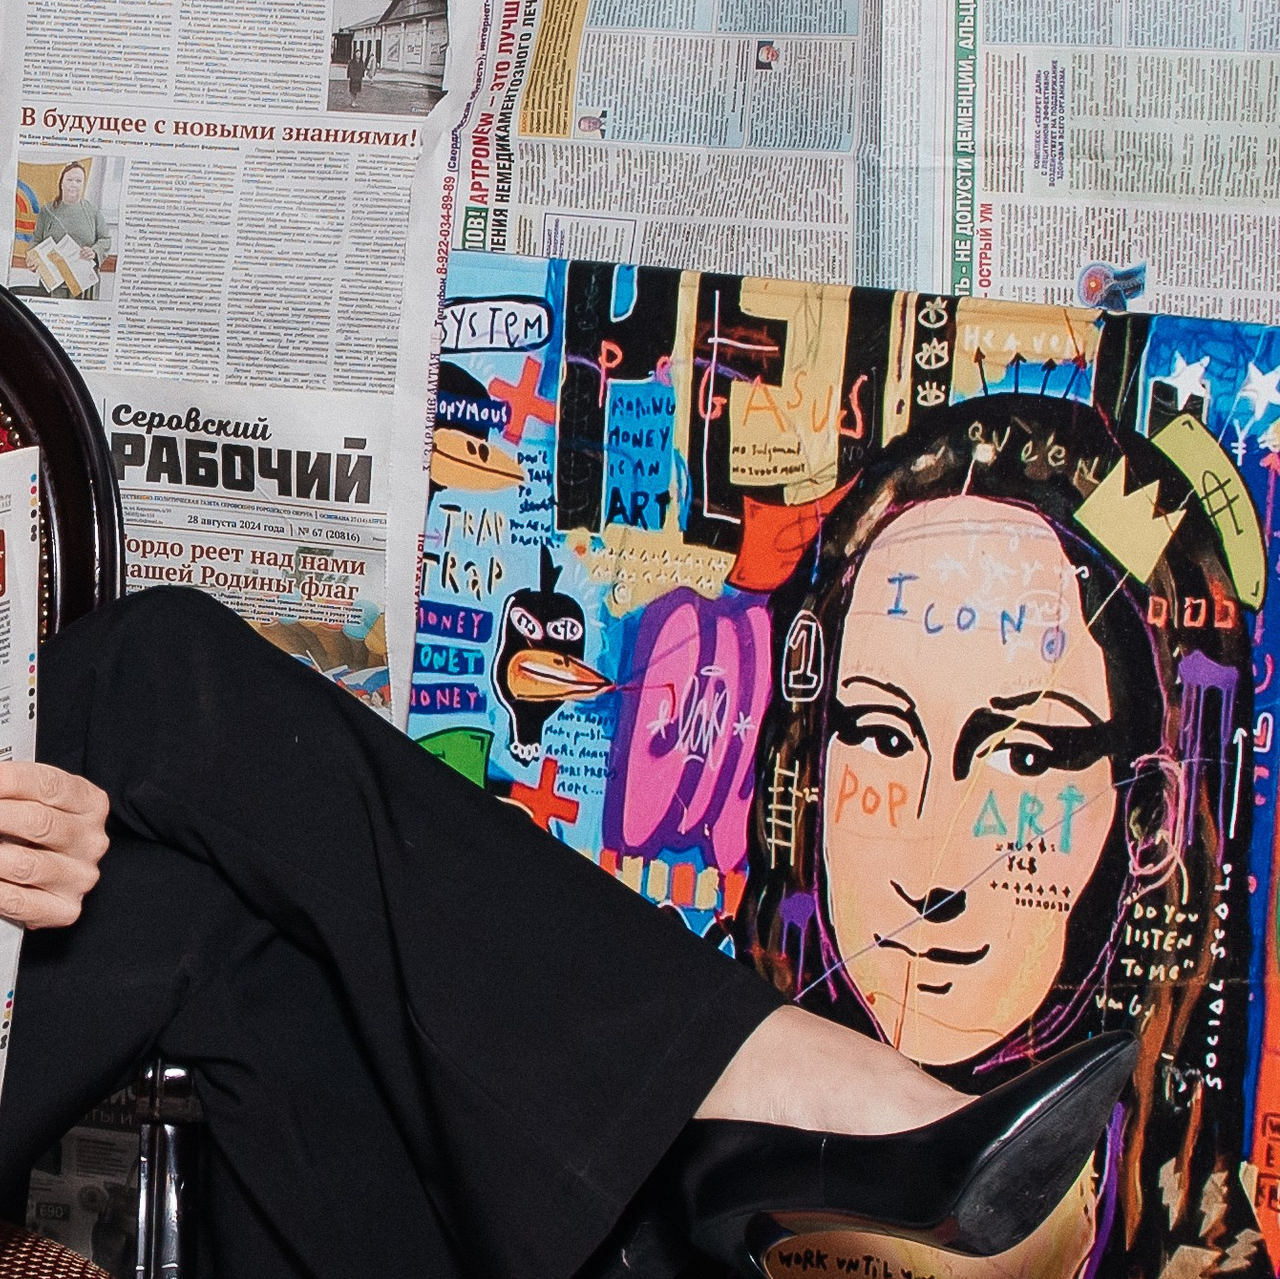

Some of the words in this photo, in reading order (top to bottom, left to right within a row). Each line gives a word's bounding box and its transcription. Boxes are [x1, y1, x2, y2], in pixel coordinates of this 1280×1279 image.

[963, 55, 977, 152] ДЕМЕНЦИИ,
[21, 106, 36, 126] В
[43, 107, 147, 137] будущее
[154, 120, 166, 135] с
[173, 120, 274, 141] новыми
[282, 127, 417, 148] знаниями!
[956, 155, 975, 231] ДОПУСТИ
[438, 176, 455, 276] 8-922-034-89-89
[956, 236, 973, 260] НЕ
[111, 404, 272, 441] Серовский
[437, 399, 507, 423] ONYMOUS
[111, 432, 372, 504] РАБОЧИЙ
[187, 515, 199, 524] 28
[201, 516, 237, 529] августа
[239, 520, 261, 531] 2024
[263, 524, 285, 534] года
[298, 526, 309, 536] №
[312, 527, 322, 537] 67
[325, 528, 361, 543] (20816)
[439, 503, 504, 547] TRAP
[605, 486, 672, 530] ART
[191, 542, 243, 563] реет
[250, 549, 294, 569] над
[301, 554, 366, 576] нами
[200, 566, 293, 593] Родины
[301, 577, 359, 600] флаг
[836, 764, 909, 827] POP
